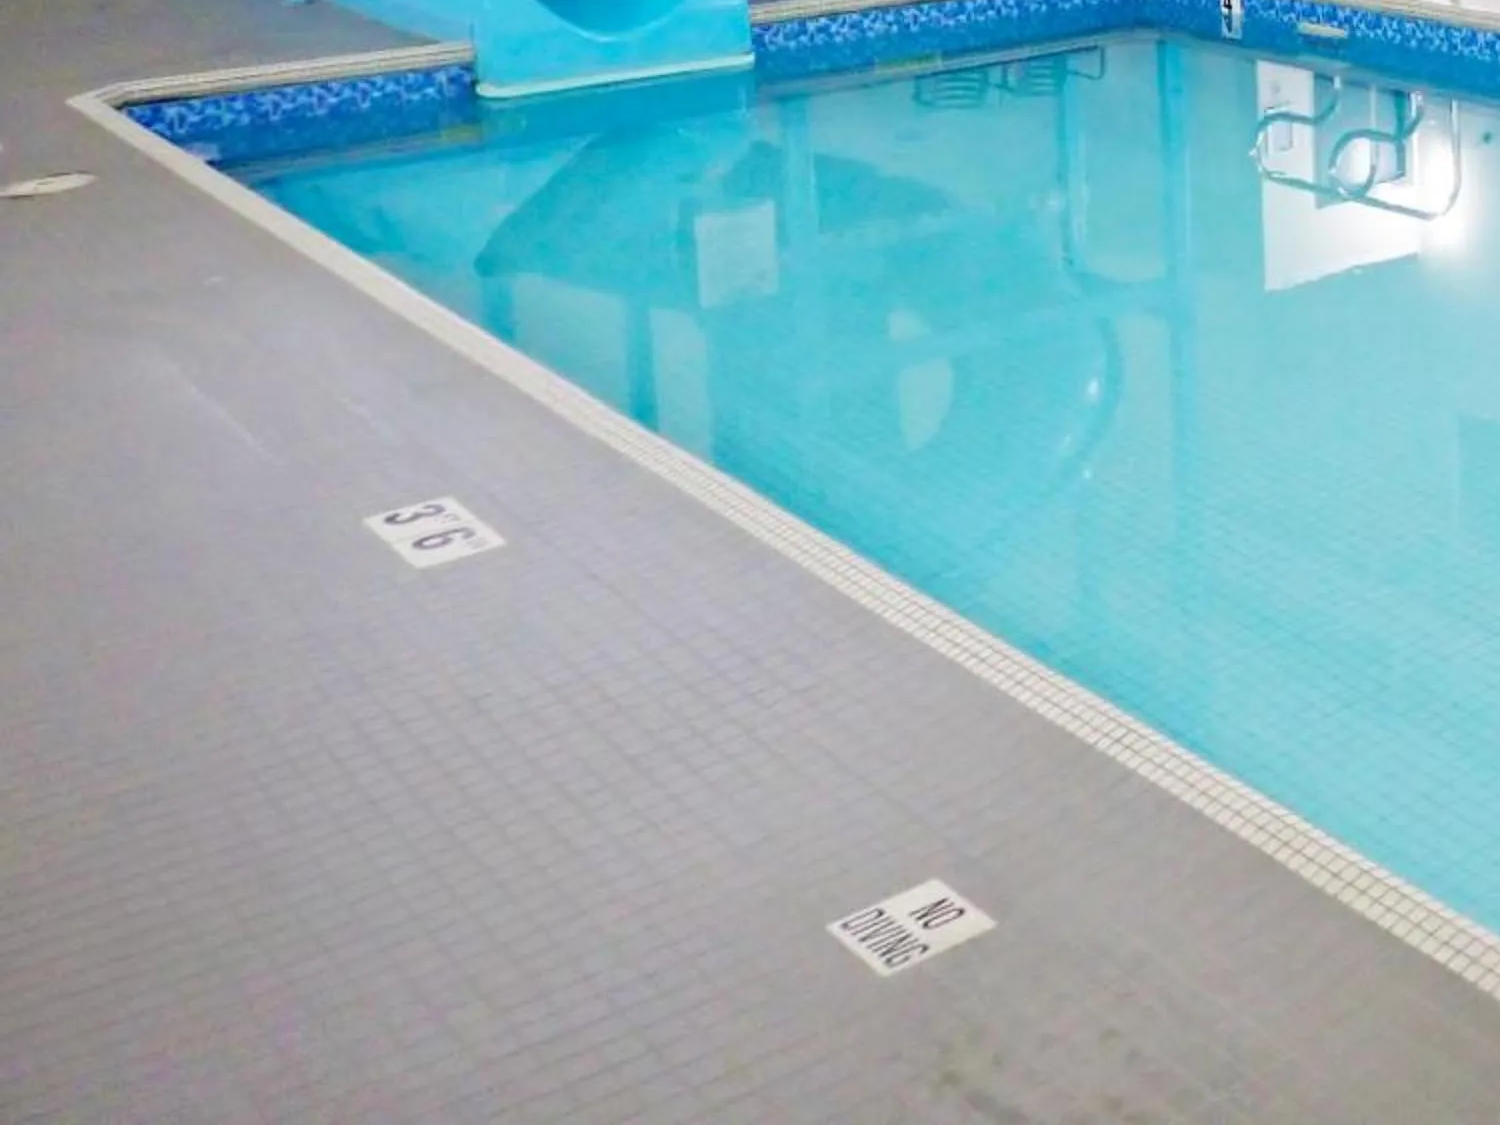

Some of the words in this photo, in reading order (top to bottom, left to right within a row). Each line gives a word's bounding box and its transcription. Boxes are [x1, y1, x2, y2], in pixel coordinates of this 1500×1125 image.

[384, 504, 446, 525] 3
[411, 526, 477, 550] 6
[909, 897, 966, 929] NO
[841, 908, 930, 969] DIVING
